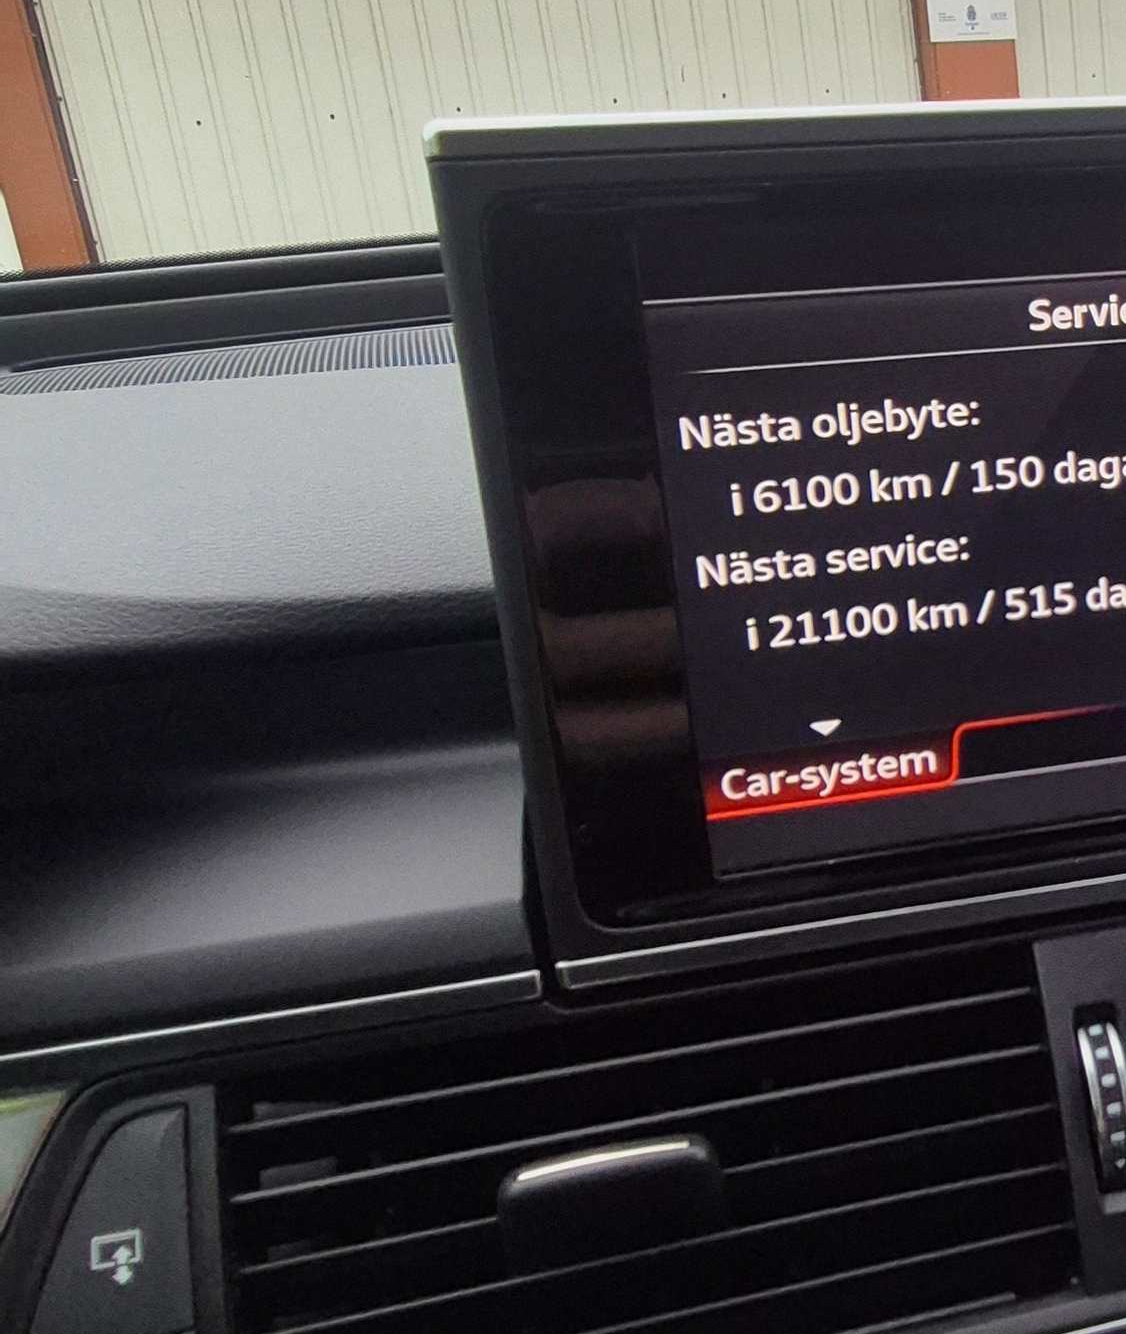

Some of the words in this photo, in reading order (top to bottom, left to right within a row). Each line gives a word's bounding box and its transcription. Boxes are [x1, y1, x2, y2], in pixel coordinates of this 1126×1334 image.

[678, 412, 802, 451] Nästa
[812, 398, 980, 446] oljebyte:
[730, 483, 744, 517] i
[753, 472, 860, 513] 6100
[869, 468, 932, 503] km
[940, 461, 959, 496] /
[970, 455, 1045, 493] 150
[695, 550, 816, 589] Nästa
[825, 534, 970, 574] service:
[745, 617, 759, 651] i
[768, 602, 898, 648] 21100
[907, 598, 969, 632] km
[976, 589, 995, 624] /
[1005, 581, 1077, 620] 515
[721, 750, 937, 800] Car-system
